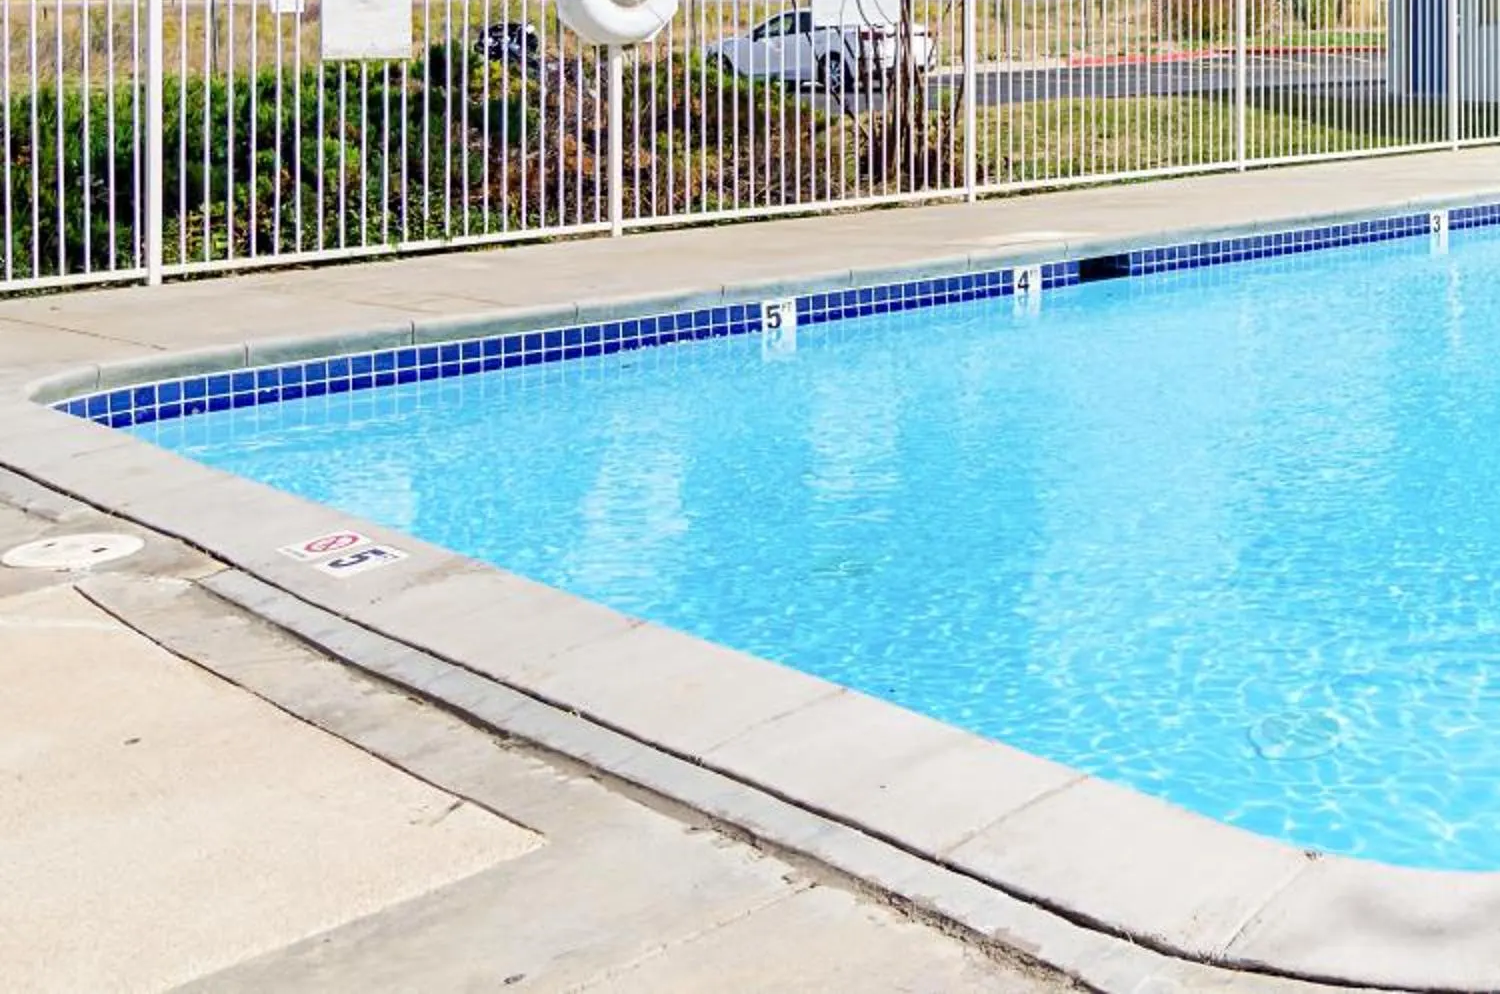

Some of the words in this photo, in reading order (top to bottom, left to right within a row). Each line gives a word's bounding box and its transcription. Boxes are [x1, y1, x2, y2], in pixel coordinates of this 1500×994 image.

[1432, 215, 1441, 233] 3
[1017, 270, 1030, 293] 4
[766, 304, 782, 328] 5
